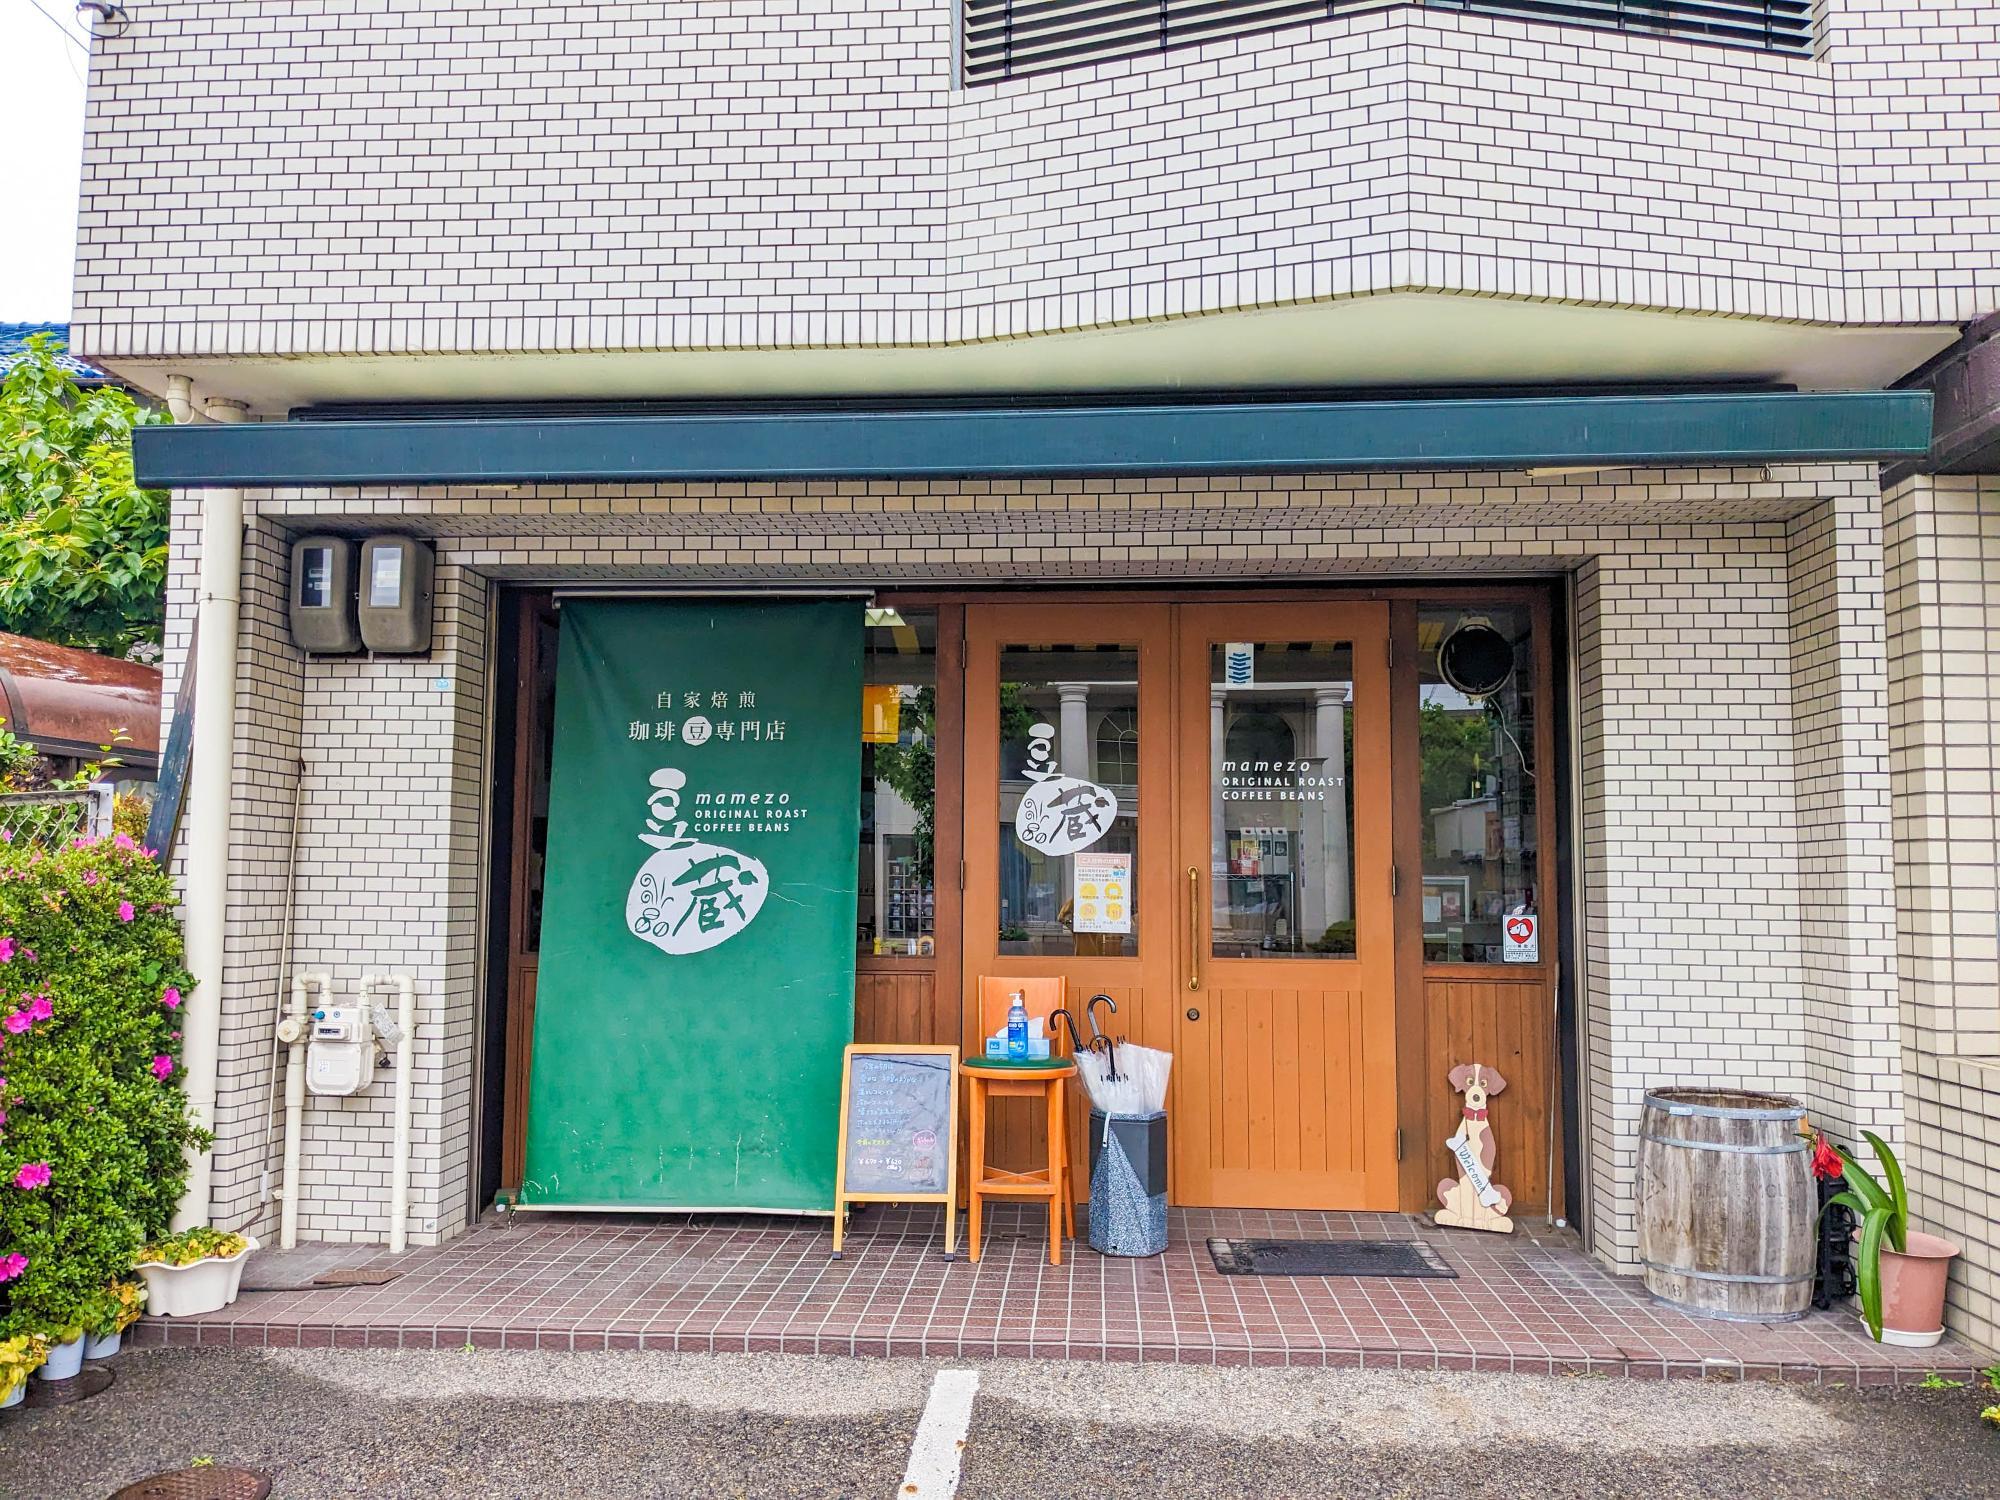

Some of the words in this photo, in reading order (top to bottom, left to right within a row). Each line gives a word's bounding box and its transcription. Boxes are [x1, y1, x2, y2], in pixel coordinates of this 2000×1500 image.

[656, 691, 756, 709] 自家焙煎
[628, 720, 785, 742] 珈琲豆専門店
[1221, 760, 1311, 772] mamezo
[1221, 777, 1291, 787] ORIGINAL
[1298, 777, 1344, 787] ROAST
[695, 792, 790, 805] mamezo
[1221, 791, 1272, 801] COFFEE
[1280, 791, 1325, 801] BEANS
[694, 810, 759, 819] ORIGINAL
[766, 809, 808, 819] ROAST
[694, 823, 742, 832] COFFEE
[748, 822, 790, 832] BEANS
